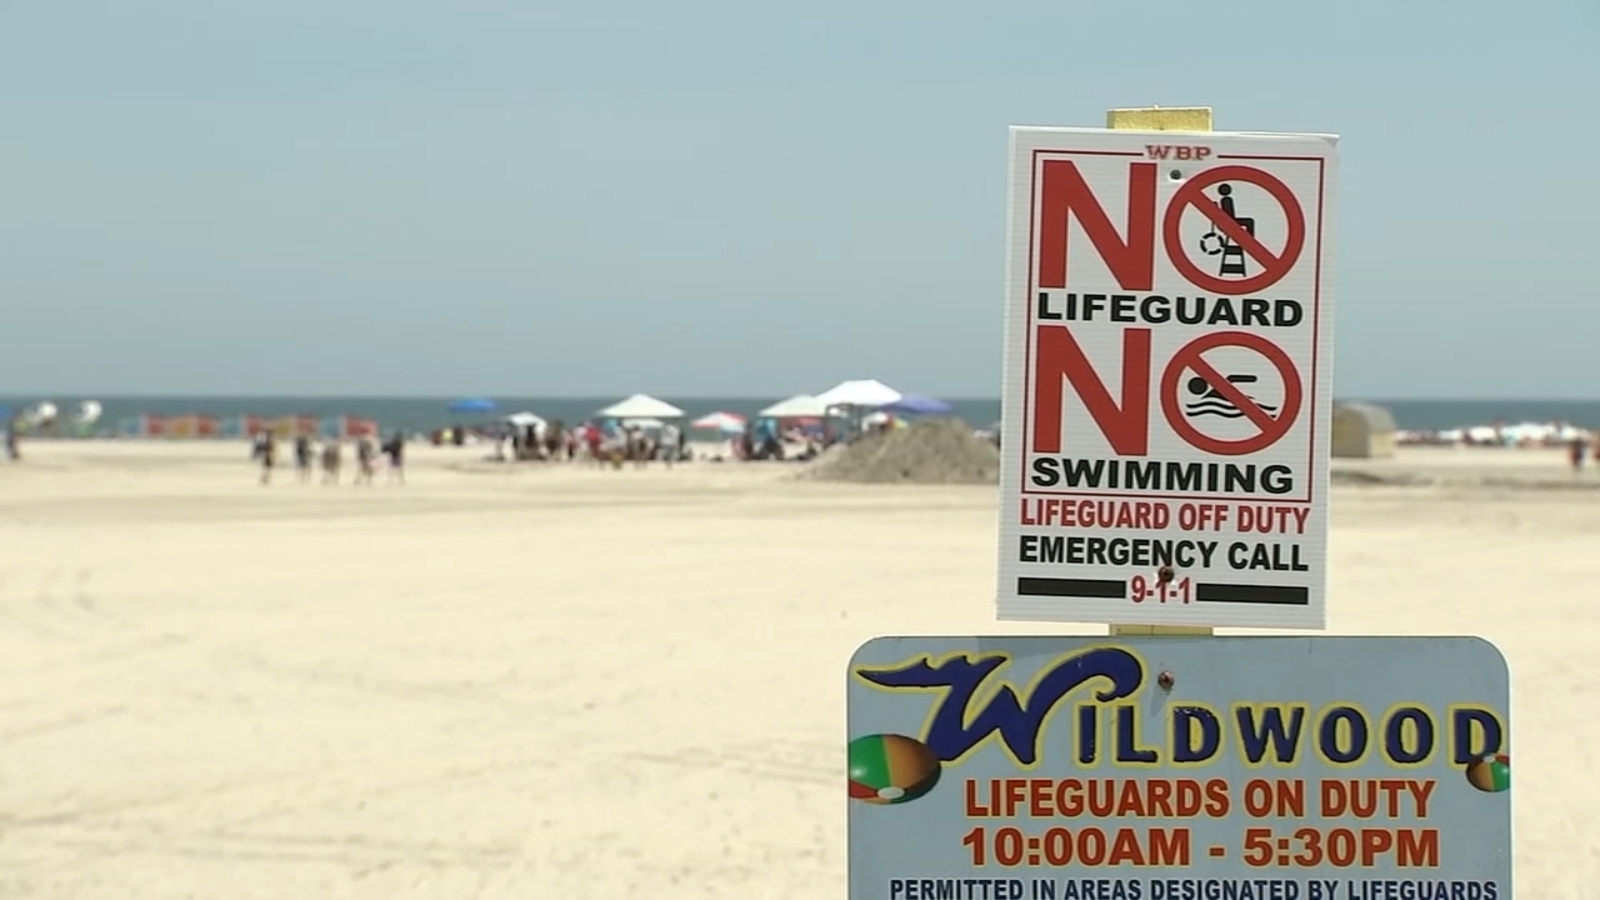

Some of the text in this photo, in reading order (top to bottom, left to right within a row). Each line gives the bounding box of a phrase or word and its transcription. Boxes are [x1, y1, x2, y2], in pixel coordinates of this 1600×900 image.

[1145, 144, 1212, 161] WBP
[1037, 292, 1303, 327] LIFEGUARD
[1031, 457, 1293, 494] SWIMMING
[1020, 498, 1311, 535] LIFEGUARD OFF DUTY
[1019, 535, 1309, 572] EMERGENCY CALL
[1130, 575, 1191, 605] 9-1-1
[965, 778, 1436, 818] LIFEGUARDS ON DUTY
[962, 827, 1190, 867] 10:00AM
[1243, 828, 1440, 868] 5:30PM
[890, 879, 1498, 900] PERMITTED IN AREAS DESIGNATED BY LIFEGUARDS
